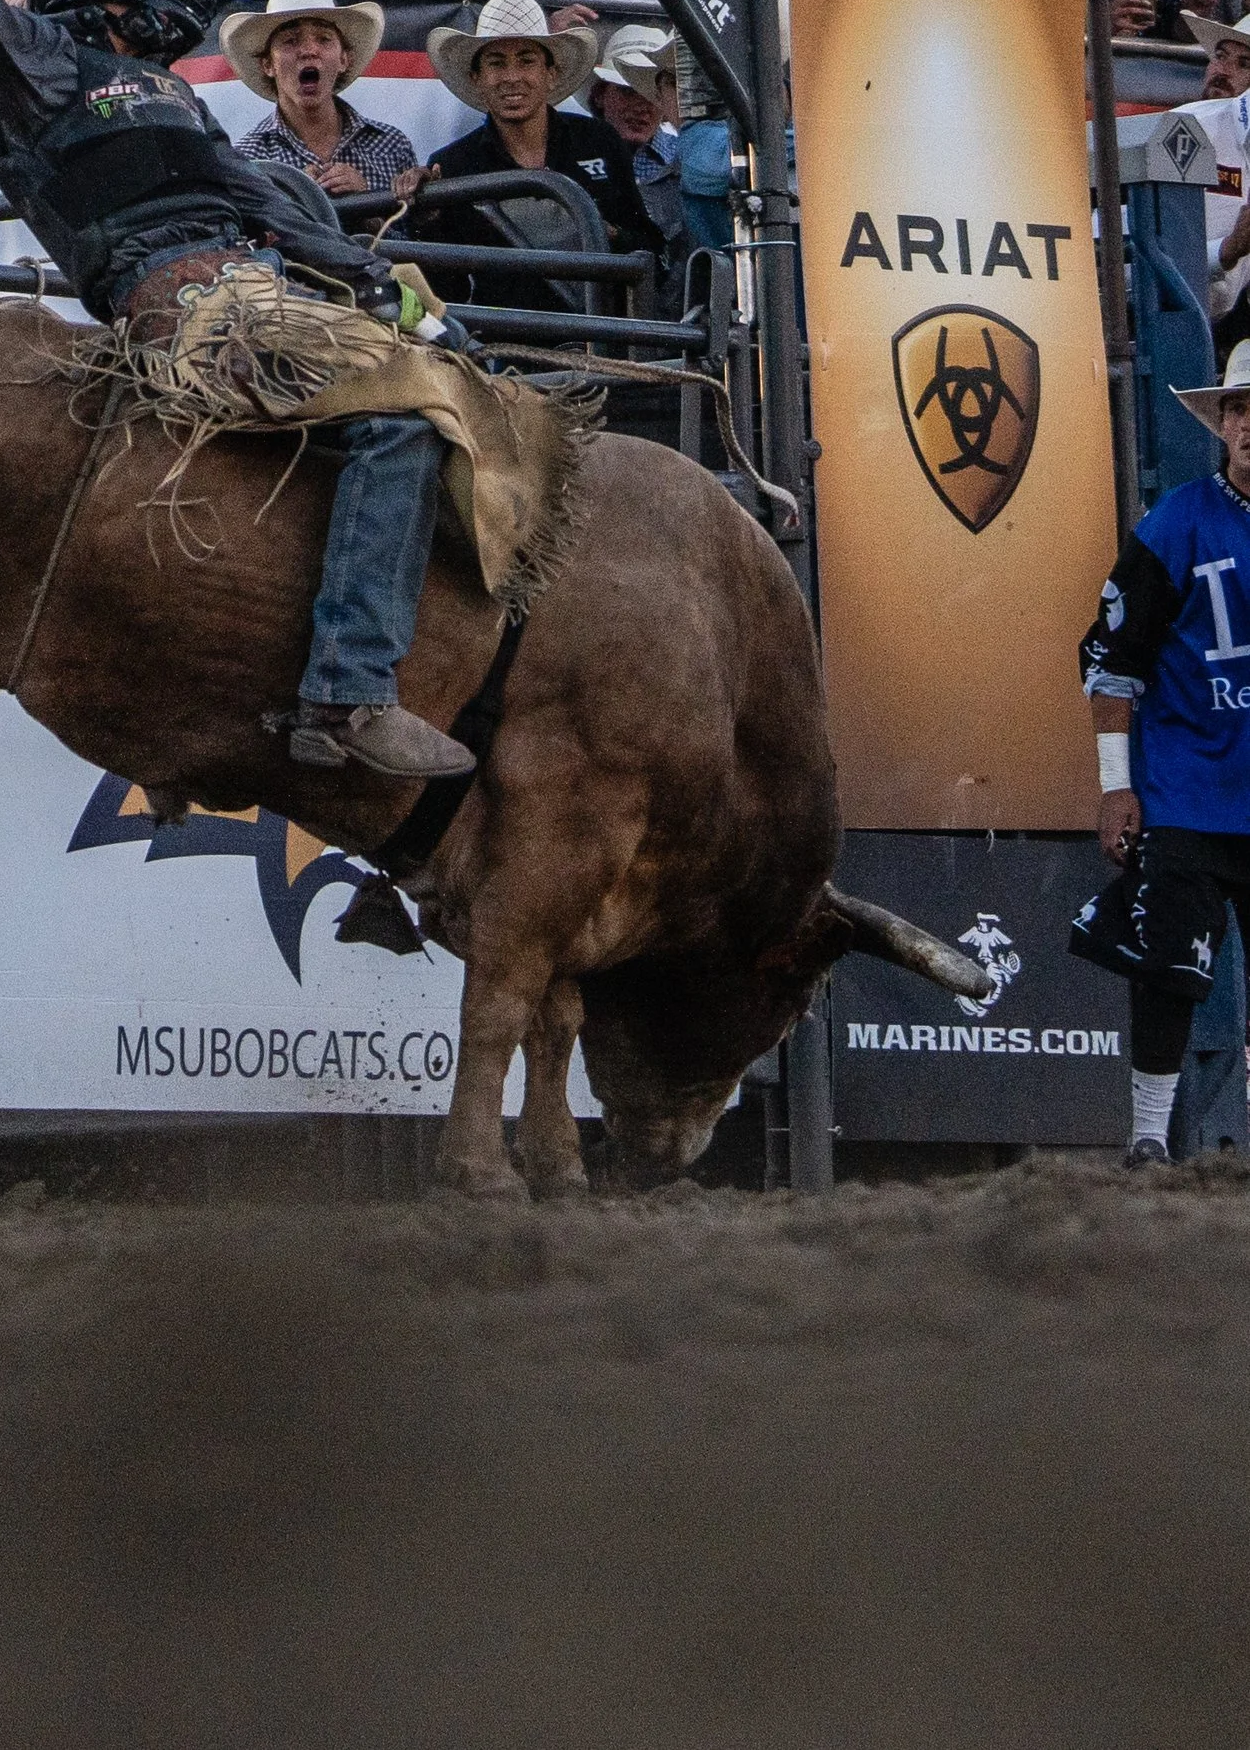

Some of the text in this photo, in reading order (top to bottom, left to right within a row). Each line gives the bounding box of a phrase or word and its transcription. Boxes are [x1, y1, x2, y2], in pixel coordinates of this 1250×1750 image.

[839, 211, 1072, 281] ARIAT
[115, 1025, 454, 1083] MSUBOBCATS.CO
[846, 1022, 1121, 1057] MARINES.COM
